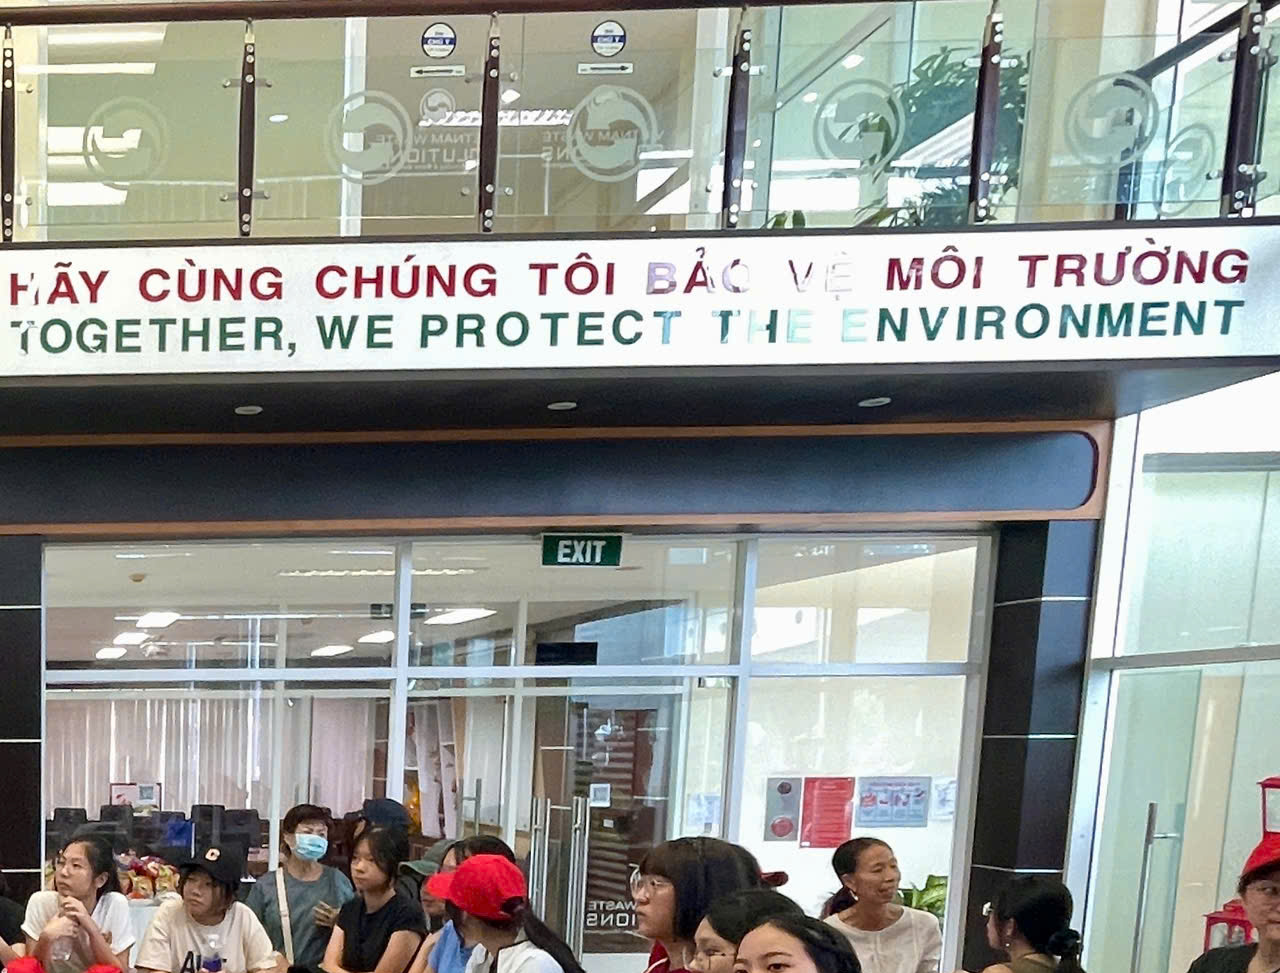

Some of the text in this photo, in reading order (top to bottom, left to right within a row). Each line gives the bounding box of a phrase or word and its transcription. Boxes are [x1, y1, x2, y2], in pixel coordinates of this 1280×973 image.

[10, 261, 110, 306] HÃY
[138, 258, 284, 303] CÙNG
[315, 254, 497, 299] CHÚNG
[528, 252, 616, 296] TÔI
[645, 246, 750, 295] BẢO
[885, 245, 984, 291] MÔI
[1018, 238, 1250, 289] TRƯỜNG
[10, 300, 1246, 357] TOGETHER, WE PROTECT THE ENVIRONMENT
[557, 539, 607, 564] EXIT
